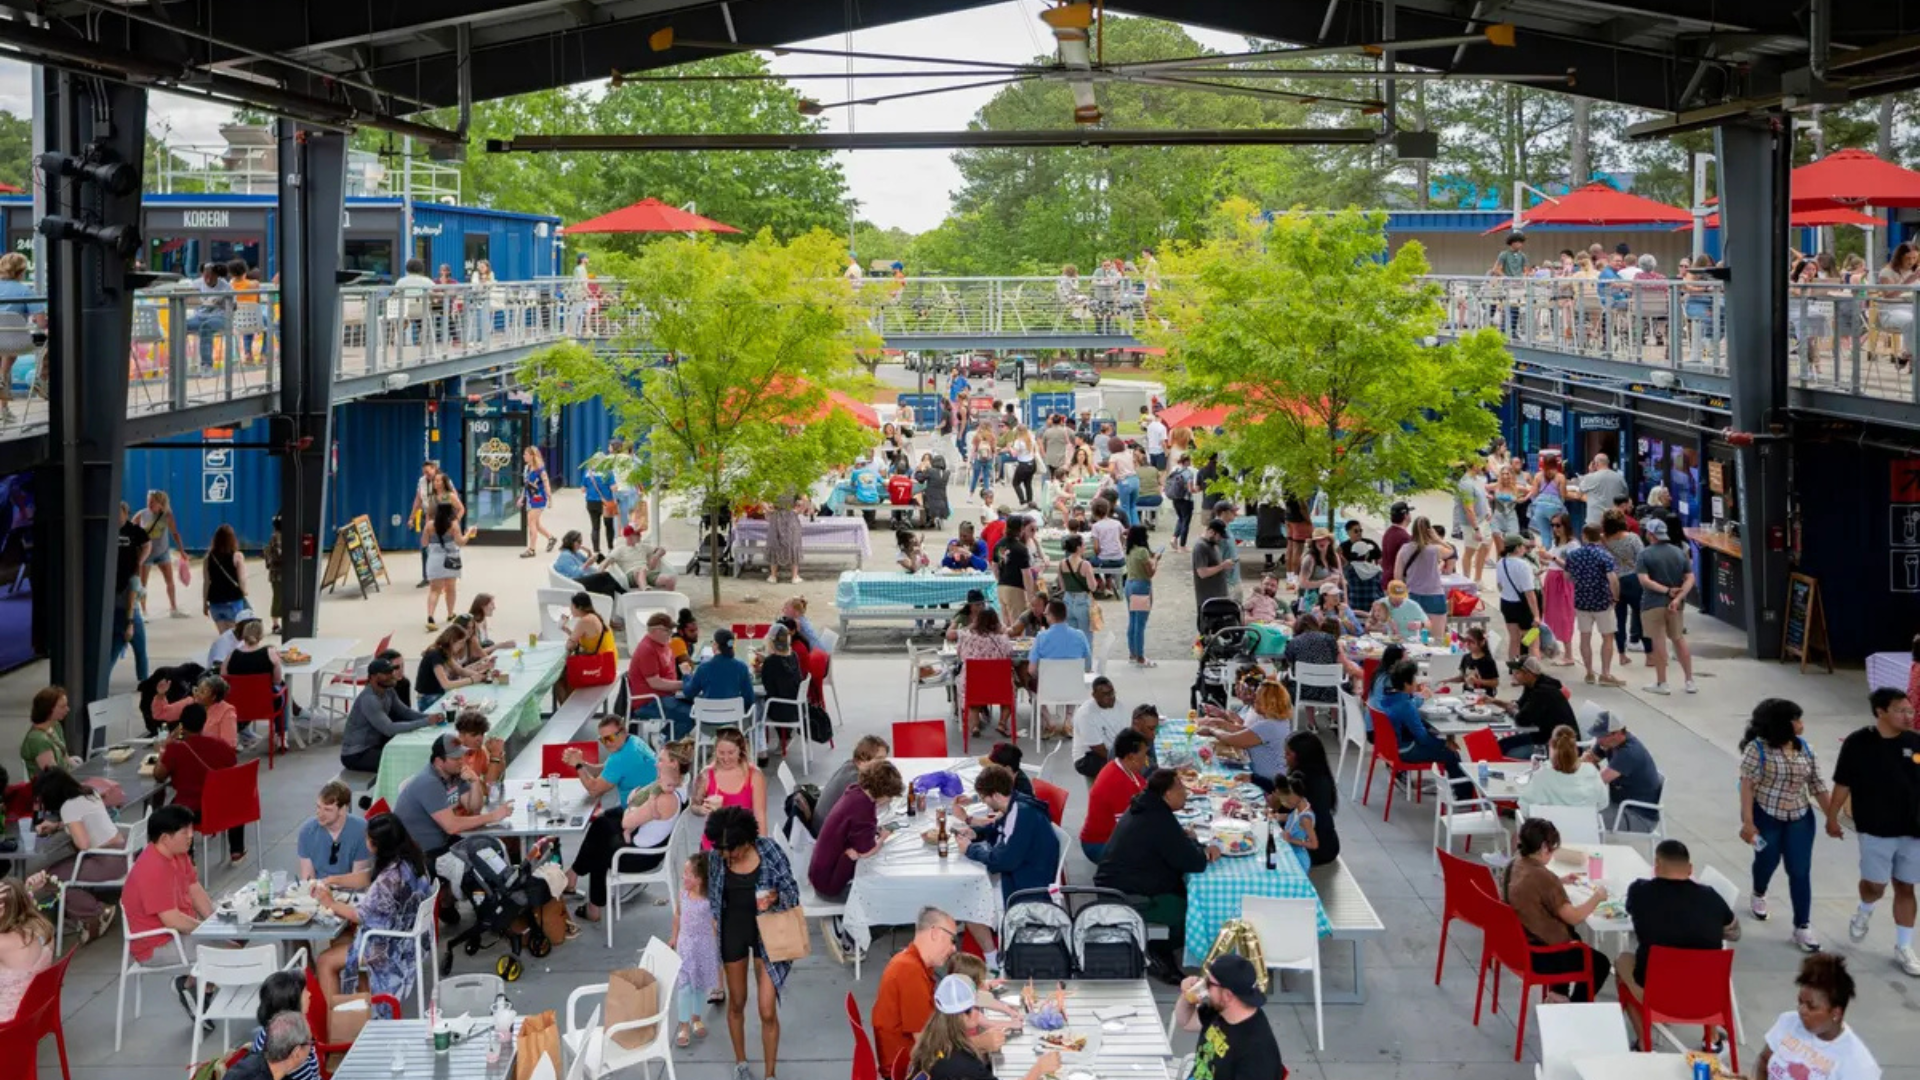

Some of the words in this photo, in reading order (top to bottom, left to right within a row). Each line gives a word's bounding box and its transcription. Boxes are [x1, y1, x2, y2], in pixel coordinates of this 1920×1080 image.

[183, 210, 229, 227] KOREAN
[469, 421, 490, 433] 160
[897, 487, 905, 500] 7
